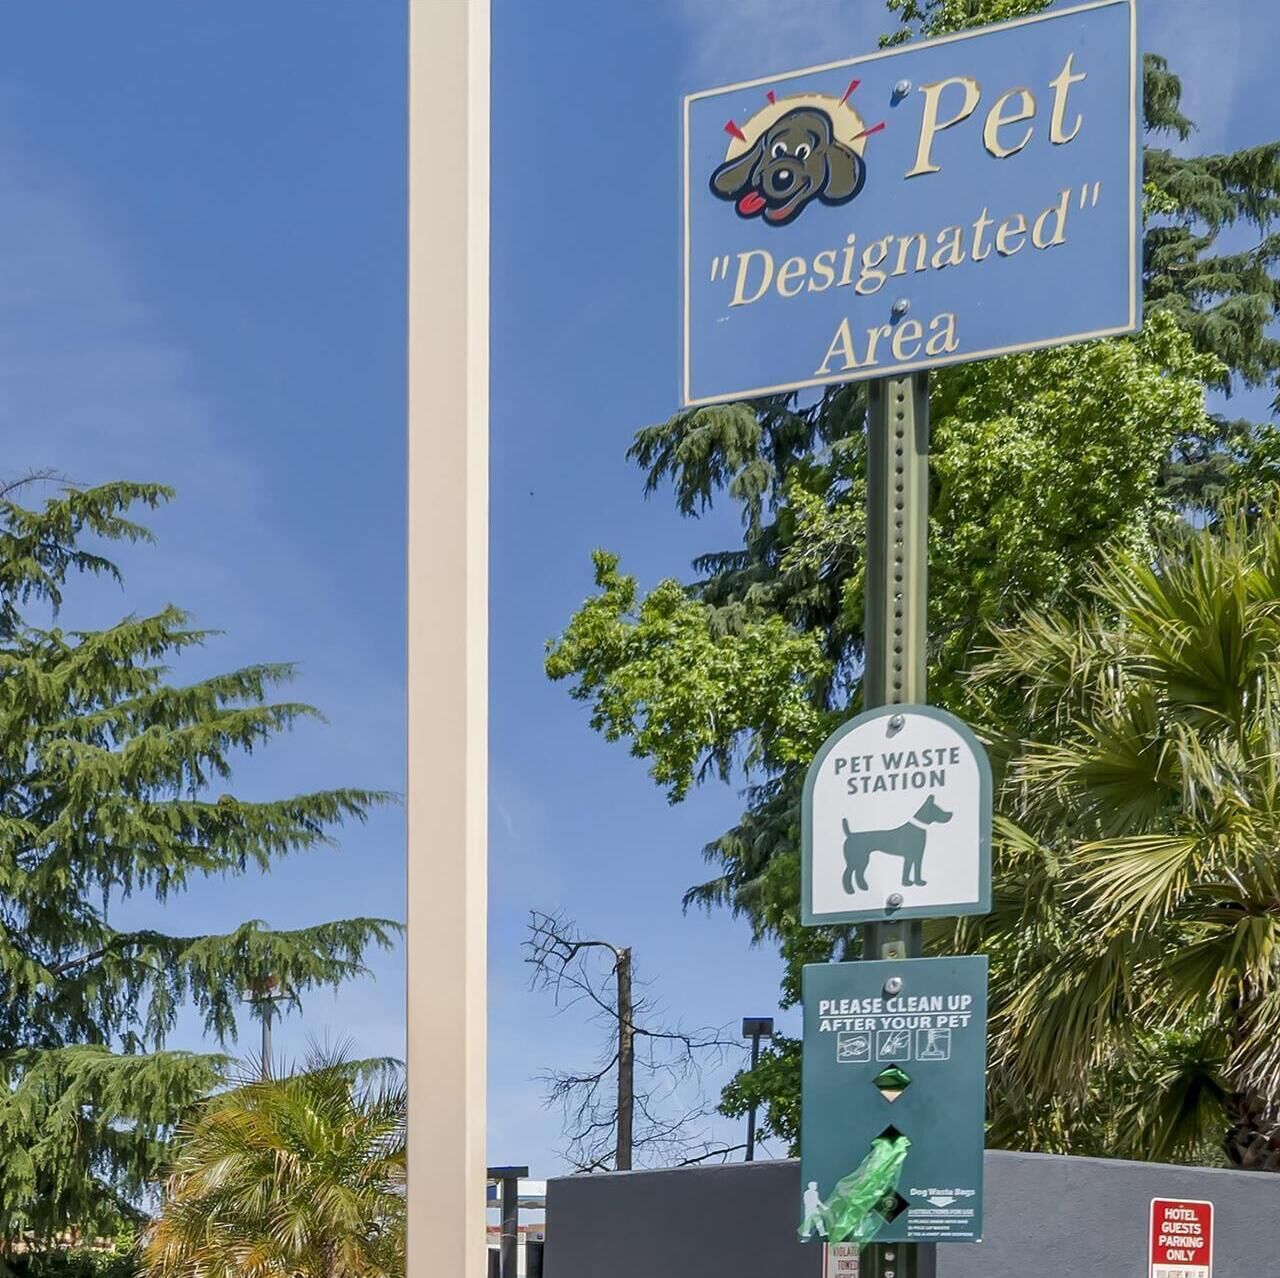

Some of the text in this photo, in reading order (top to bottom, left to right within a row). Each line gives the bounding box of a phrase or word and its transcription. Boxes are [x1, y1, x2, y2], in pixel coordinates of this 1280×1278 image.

[904, 52, 1088, 180] Pet
[709, 181, 1101, 307] "Designated"
[814, 311, 960, 375] Area
[834, 746, 960, 775] PET WASTE
[846, 769, 945, 795] STATION
[819, 995, 972, 1015] PLEASE CLEAN UP
[819, 1015, 971, 1032] AFTER YOUR PET
[909, 1188, 976, 1197] Dog Waste Bags
[1164, 1208, 1199, 1221] HOTEL
[1161, 1221, 1202, 1235] GUESTS
[1158, 1235, 1204, 1248] PARKING
[1166, 1249, 1196, 1262] ONLY
